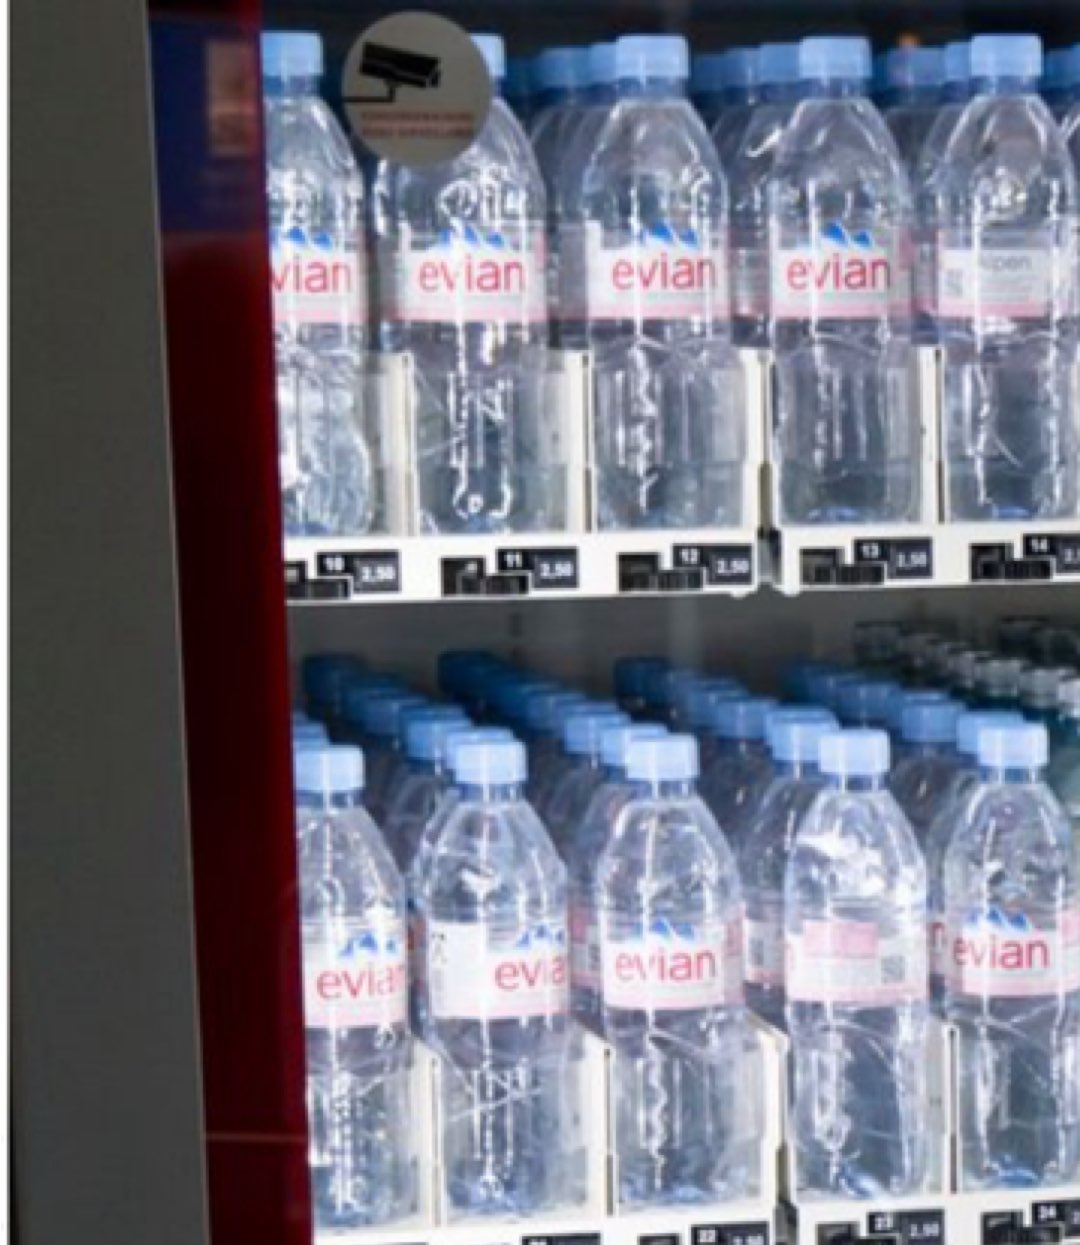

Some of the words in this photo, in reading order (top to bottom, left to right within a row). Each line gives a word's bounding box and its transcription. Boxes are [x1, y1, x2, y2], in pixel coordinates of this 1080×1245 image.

[418, 255, 525, 294] evian
[612, 252, 717, 291] evian
[786, 252, 891, 291] evian
[615, 949, 717, 984] evian
[953, 933, 1050, 970] evian
